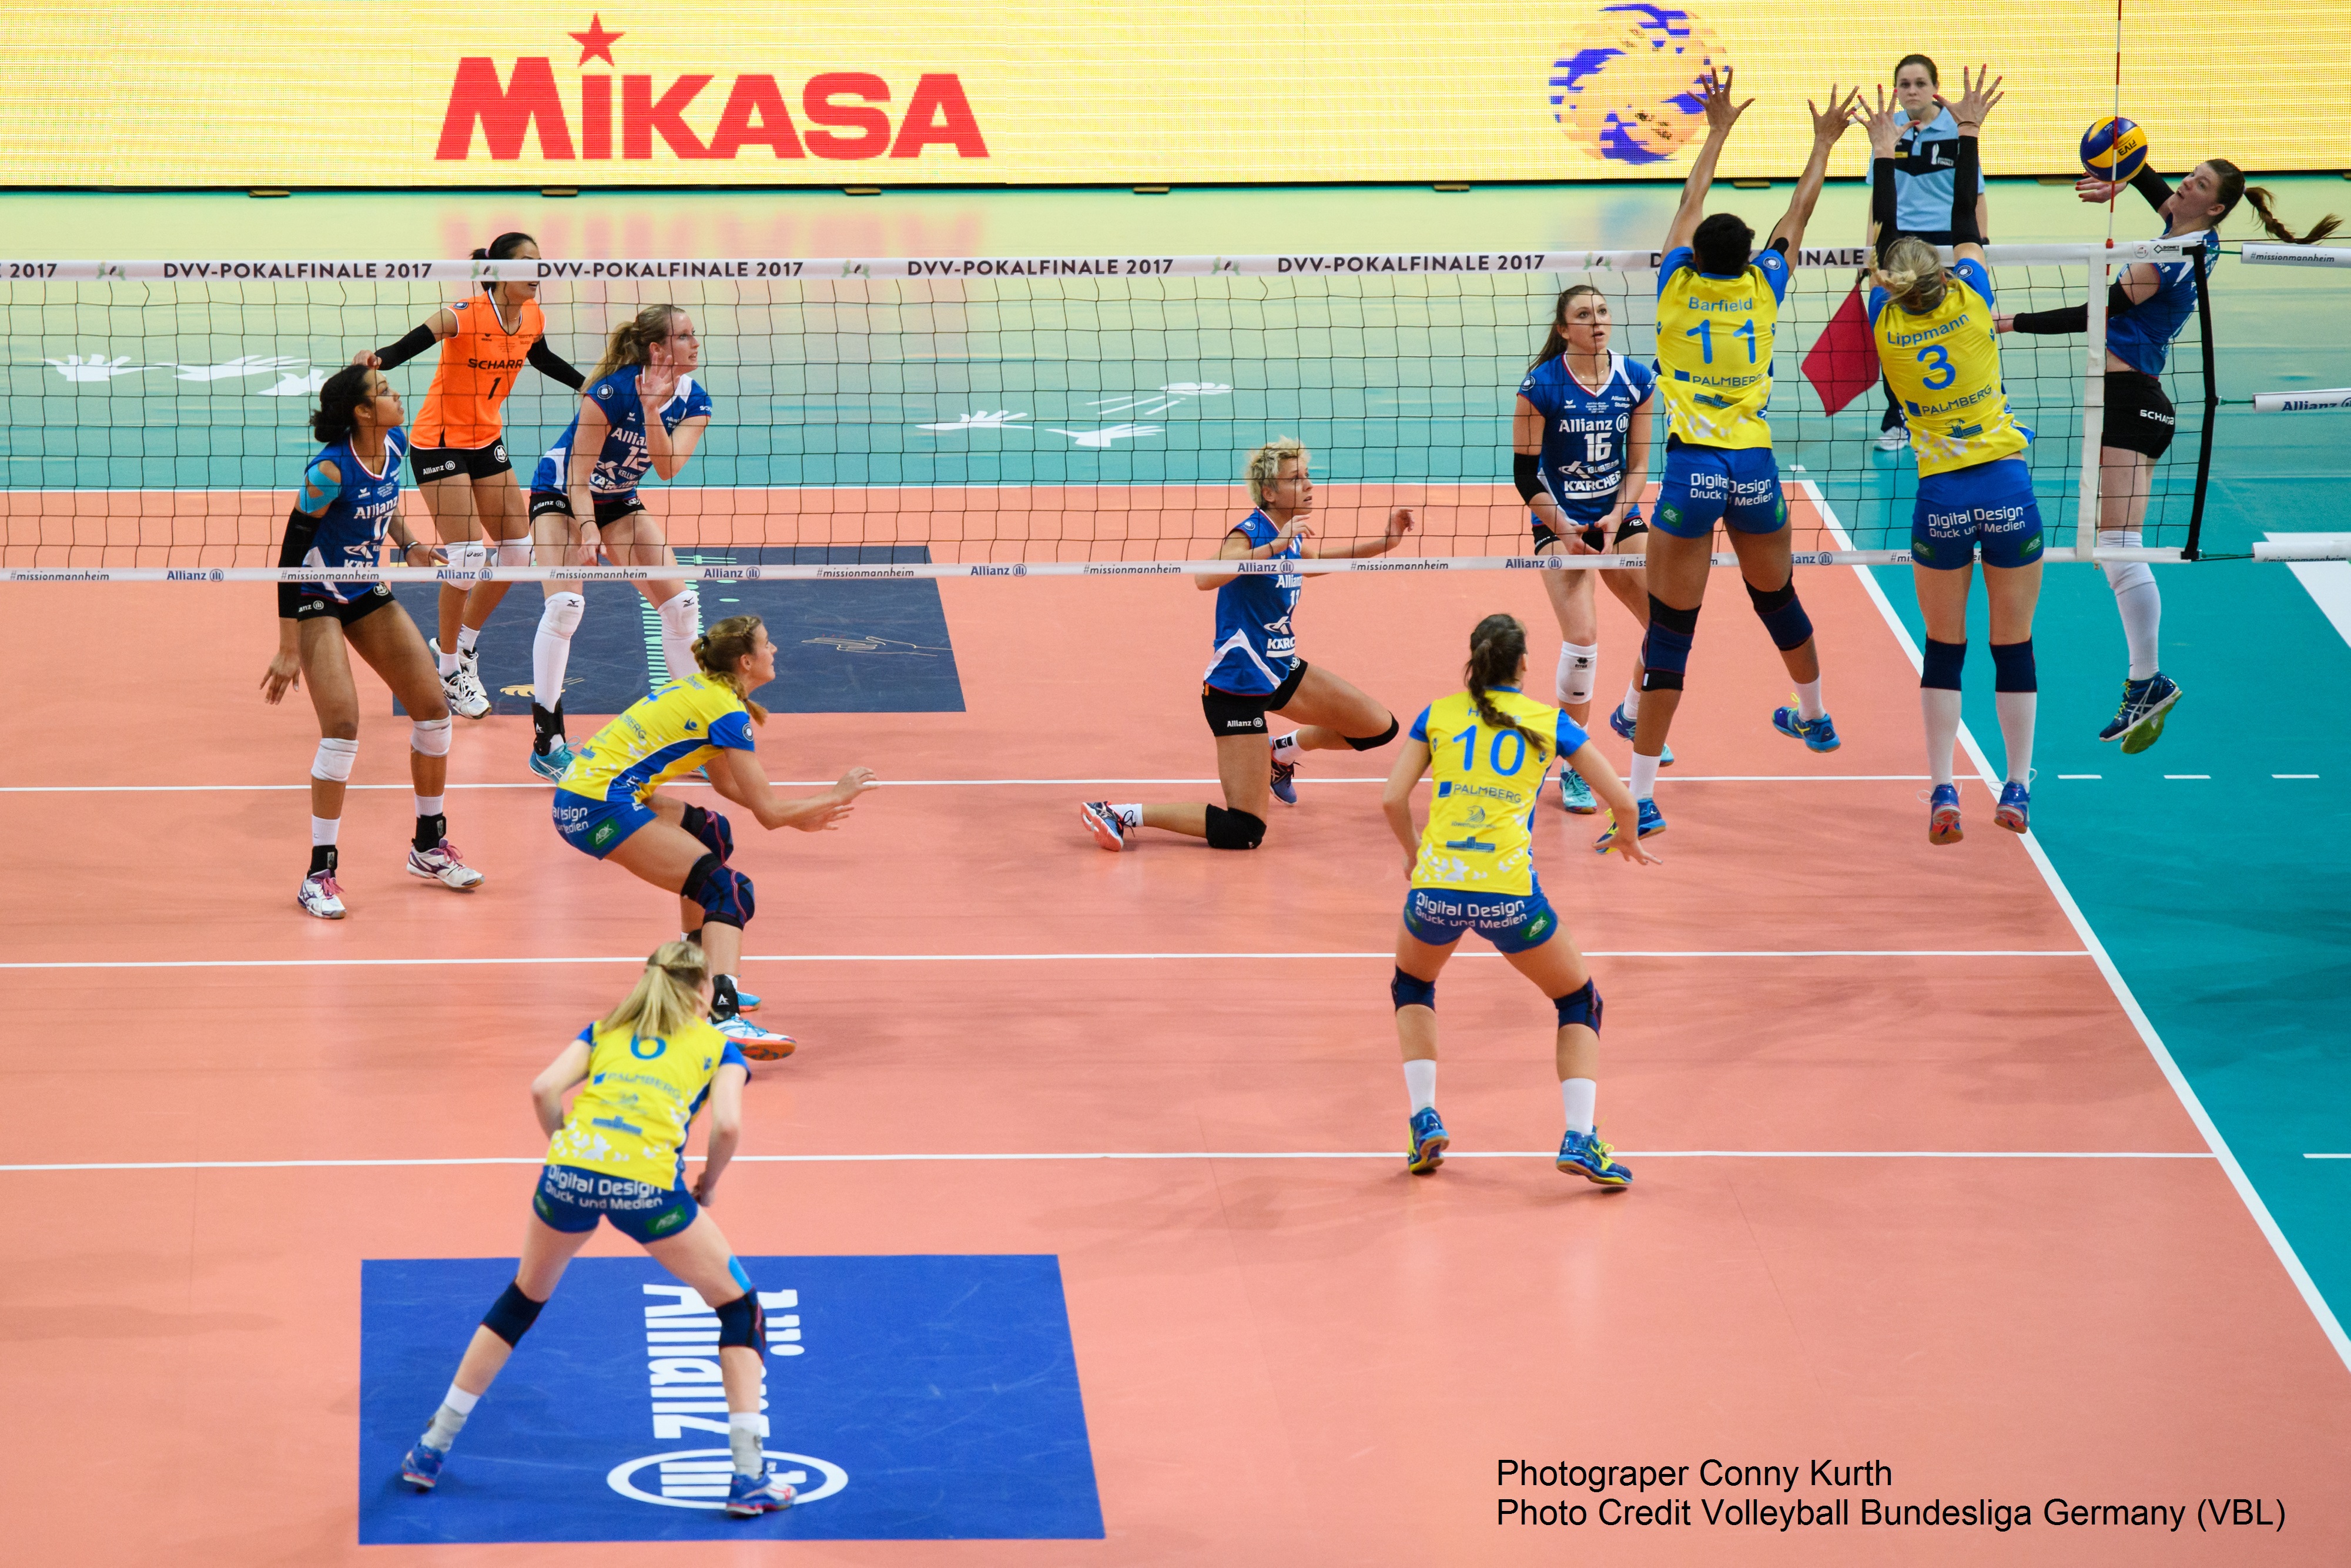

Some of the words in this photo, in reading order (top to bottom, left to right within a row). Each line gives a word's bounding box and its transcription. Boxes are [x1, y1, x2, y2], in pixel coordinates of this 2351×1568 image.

[434, 56, 990, 160] MIKASA
[1278, 256, 1490, 273] DVV-POKALFINALE
[1497, 254, 1545, 270] 2017
[2250, 252, 2335, 263] #missionmannheim
[10, 263, 58, 279] 2017
[163, 263, 377, 279] DVV-POKALFINALE
[385, 263, 433, 279] 2017
[537, 262, 749, 278] DVV-POKALFINALE
[756, 262, 804, 277] 2017
[907, 259, 1119, 276] DVV-POKALFINALE
[1126, 259, 1174, 274] 2017
[1688, 296, 1754, 313] Barfield
[1887, 315, 1970, 347] Lippmann
[1686, 319, 1756, 364] 11
[467, 357, 523, 370] SCHARR
[1917, 344, 1956, 390] 3
[487, 377, 502, 400] 1
[1922, 384, 1992, 414] PALMBERG
[2281, 401, 2337, 411] Allianz
[1559, 418, 1613, 433] Allianz
[1584, 432, 1612, 462] 16
[622, 445, 652, 472] 12
[423, 465, 444, 475] Allianz
[1564, 470, 1622, 491] KÄRCHER
[1690, 473, 1729, 490] Digital
[1729, 478, 1771, 495] Design
[1690, 488, 1722, 500] Druck
[1735, 492, 1773, 506] Medien
[354, 496, 397, 519] Allianz
[373, 511, 393, 541] 17
[1928, 510, 1971, 529] Digital
[1974, 507, 2023, 522] Design
[1930, 528, 1960, 538] Druck
[1985, 521, 2025, 533] Medien
[1237, 562, 1277, 572] Allianz
[1350, 560, 1449, 571] #missionmannheim
[1505, 558, 1545, 568] Allianz
[1791, 554, 1816, 564] ianz
[10, 570, 109, 581] #missionmannheim
[166, 570, 206, 580] Allianz
[281, 569, 379, 580] #missionmannheim
[436, 569, 475, 579] Allianz
[549, 569, 648, 579] #missionmannheim
[704, 568, 743, 578] Allianz
[816, 567, 915, 578] #missionmannheim
[970, 565, 1010, 576] Allianz
[1083, 564, 1181, 574] #missionmannheim
[1453, 725, 1526, 776] 10
[1454, 784, 1522, 803] PALMBERG
[595, 824, 614, 842] AOK
[1416, 892, 1462, 916] Digital
[1467, 900, 1525, 917] Design
[1415, 906, 1445, 926] Druck
[1450, 919, 1476, 928] und
[1480, 913, 1528, 929] Medien
[547, 1165, 594, 1195] Digital
[598, 1178, 662, 1198] Design
[579, 1198, 608, 1209] und
[610, 1197, 663, 1210] Medien
